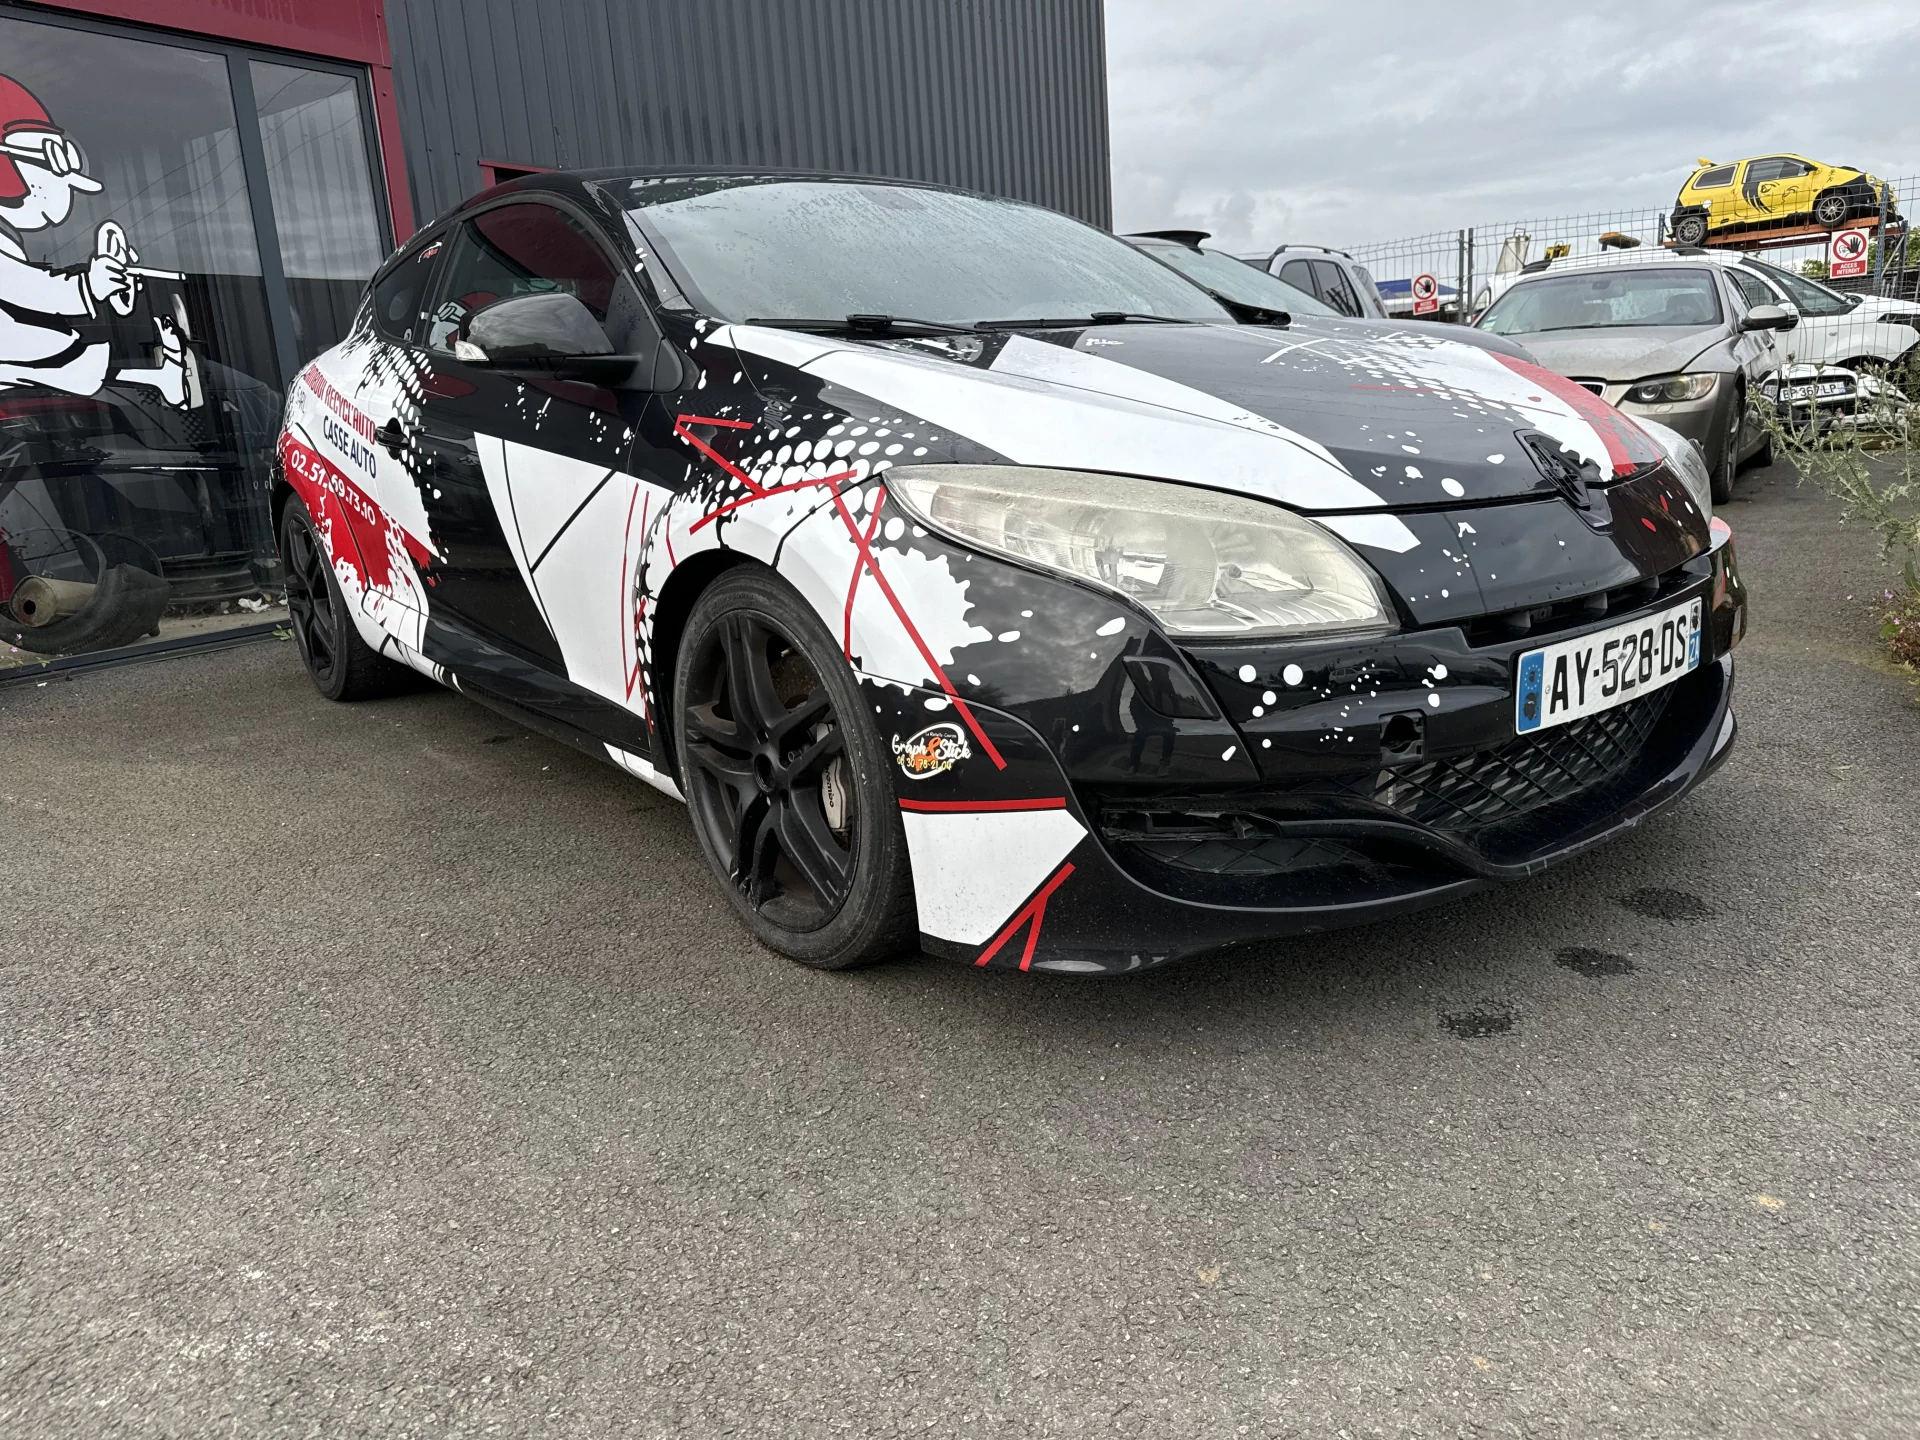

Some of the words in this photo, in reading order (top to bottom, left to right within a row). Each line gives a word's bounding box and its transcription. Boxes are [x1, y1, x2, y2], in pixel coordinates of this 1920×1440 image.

[323, 415, 349, 456] CASSE
[350, 438, 377, 479] AUTO
[1549, 614, 1687, 714] AY-528-DS
[906, 758, 916, 768] 30
